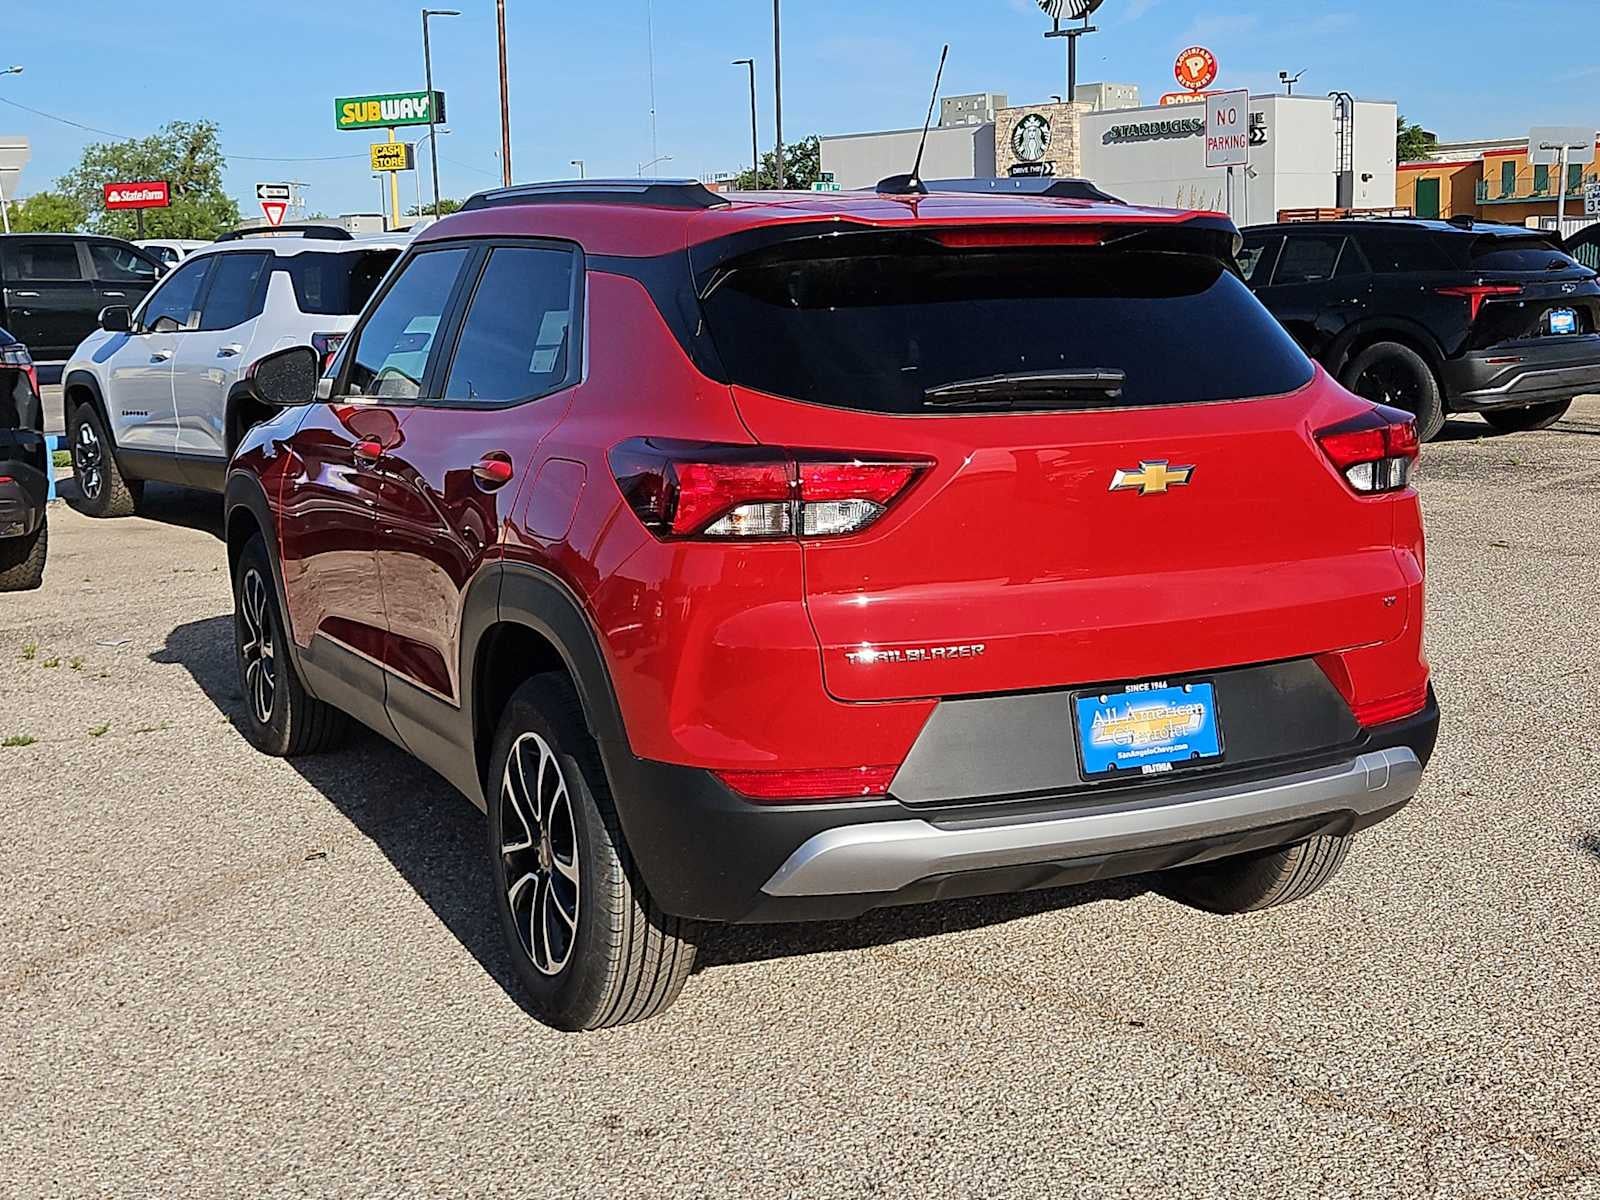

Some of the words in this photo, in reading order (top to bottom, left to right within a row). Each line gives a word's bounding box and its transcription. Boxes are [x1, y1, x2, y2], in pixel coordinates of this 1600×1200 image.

[1177, 48, 1213, 66] LOUISIANA
[340, 95, 429, 125] SUBWAY
[1217, 108, 1237, 126] NO
[1108, 118, 1201, 138] STARBUCKS
[375, 145, 401, 156] CASH
[1208, 134, 1246, 151] PARKING
[373, 155, 405, 169] STORE
[1125, 682, 1150, 693] SINCE
[1091, 706, 1118, 729] All
